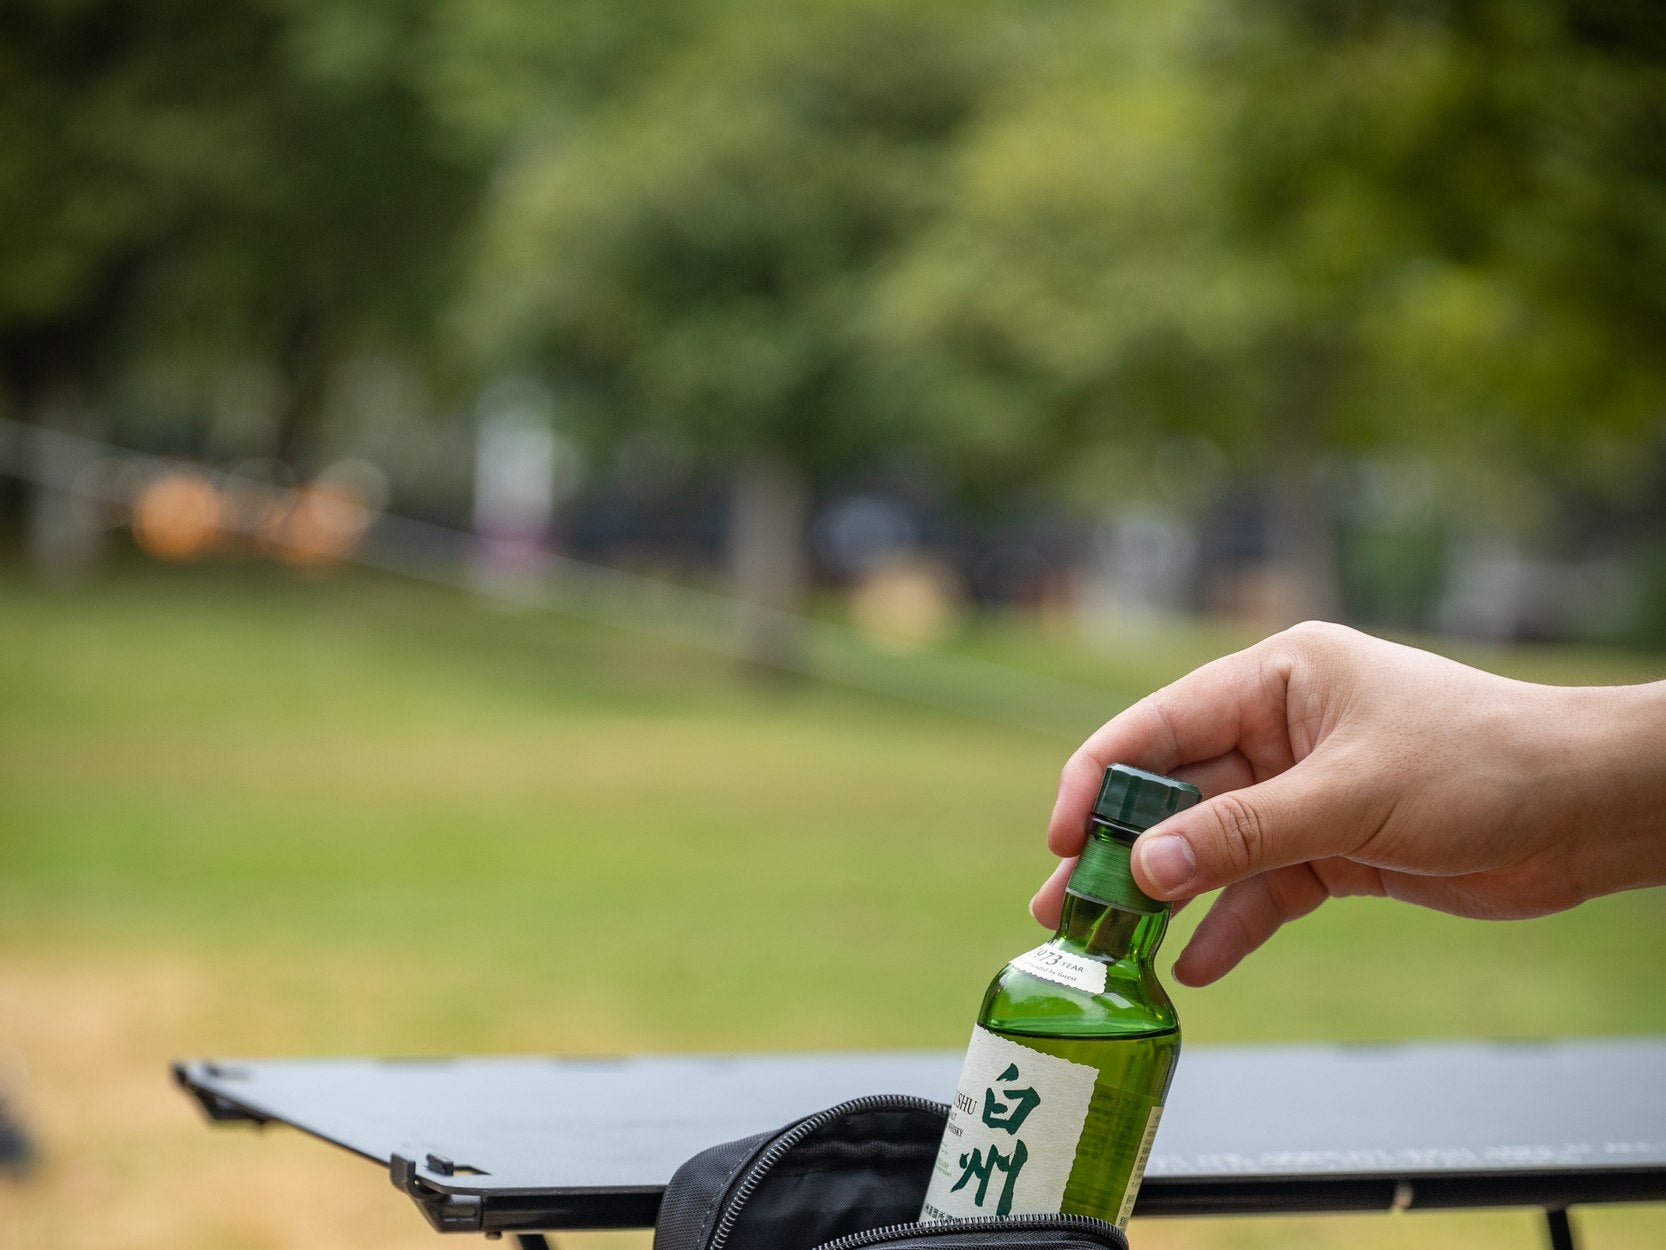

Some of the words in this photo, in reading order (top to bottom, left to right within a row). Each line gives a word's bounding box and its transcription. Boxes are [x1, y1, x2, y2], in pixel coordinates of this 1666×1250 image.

[1062, 961, 1084, 973] YEAR
[1057, 971, 1078, 983] forest
[950, 1062, 1042, 1219] 白州
